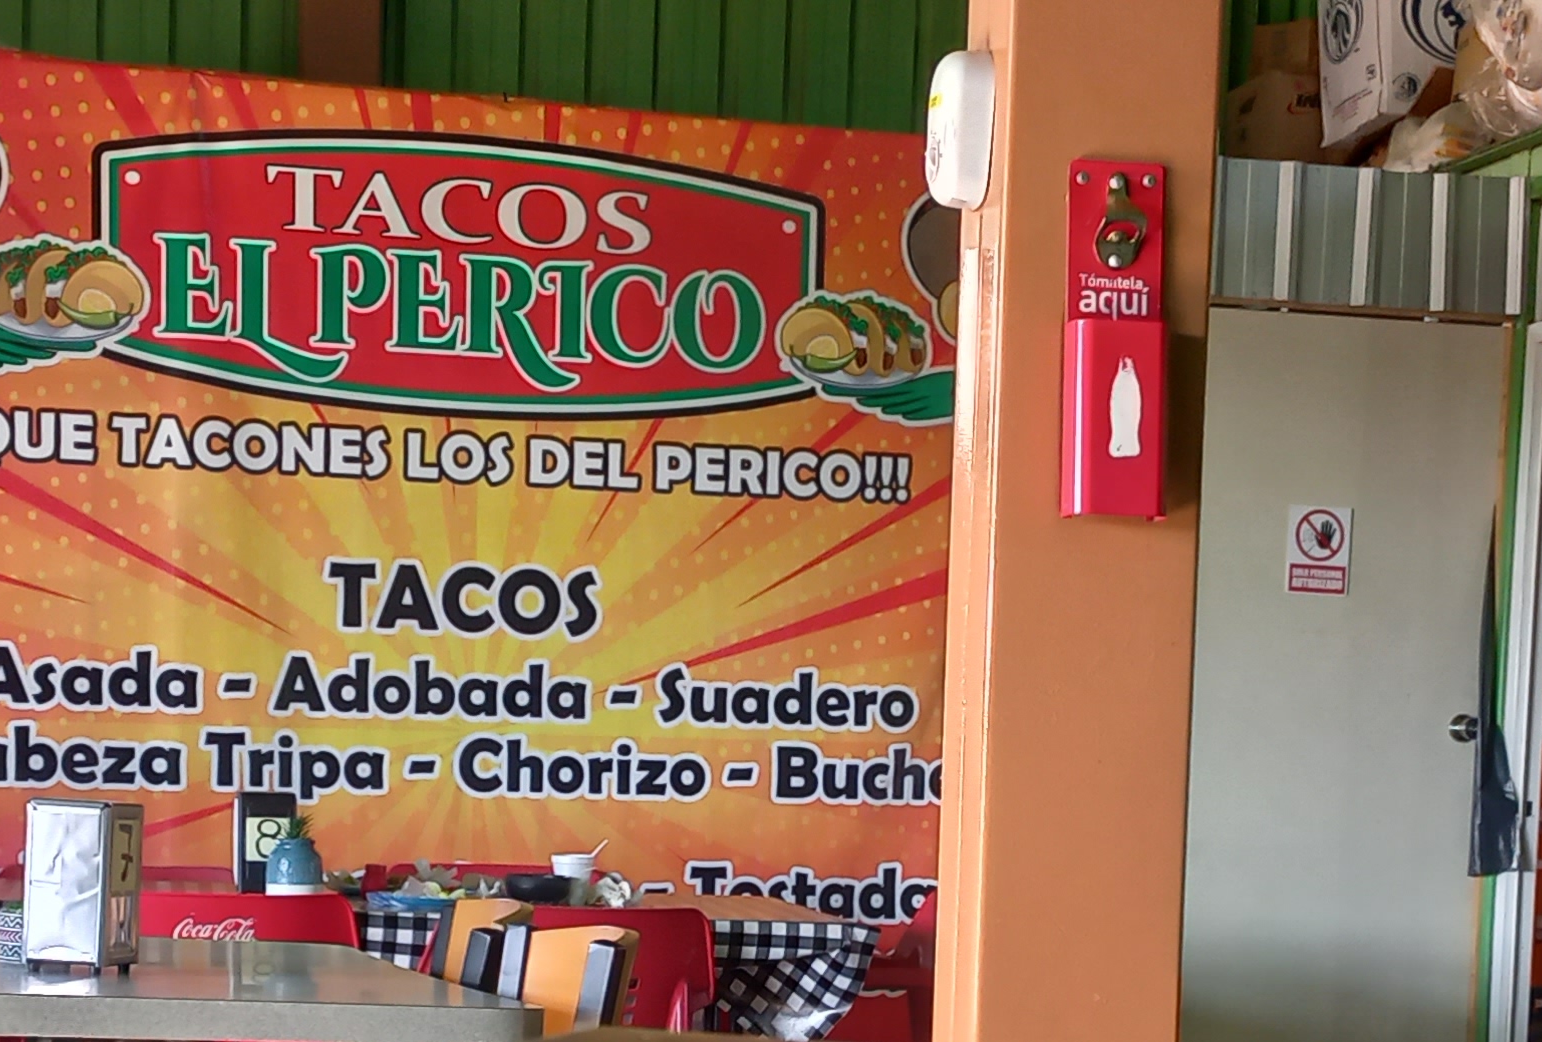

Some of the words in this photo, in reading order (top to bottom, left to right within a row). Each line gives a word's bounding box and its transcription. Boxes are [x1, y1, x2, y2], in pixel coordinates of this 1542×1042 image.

[266, 164, 652, 255] TACOS
[157, 233, 343, 381] EL
[321, 246, 763, 390] PERICO
[1079, 286, 1150, 321] aquí
[111, 415, 388, 477] TACONES
[406, 432, 511, 483] LOS
[528, 438, 639, 489] DEL
[655, 444, 912, 500] PERICO!!!
[329, 561, 598, 637] TACOS
[274, 655, 587, 720] Adobada
[659, 667, 915, 729] Suadero
[205, 731, 385, 801] Tripa
[458, 737, 706, 797] Chorizo
[117, 823, 134, 882] 7
[256, 818, 283, 860] 8
[172, 916, 258, 941] Coca-Cola
